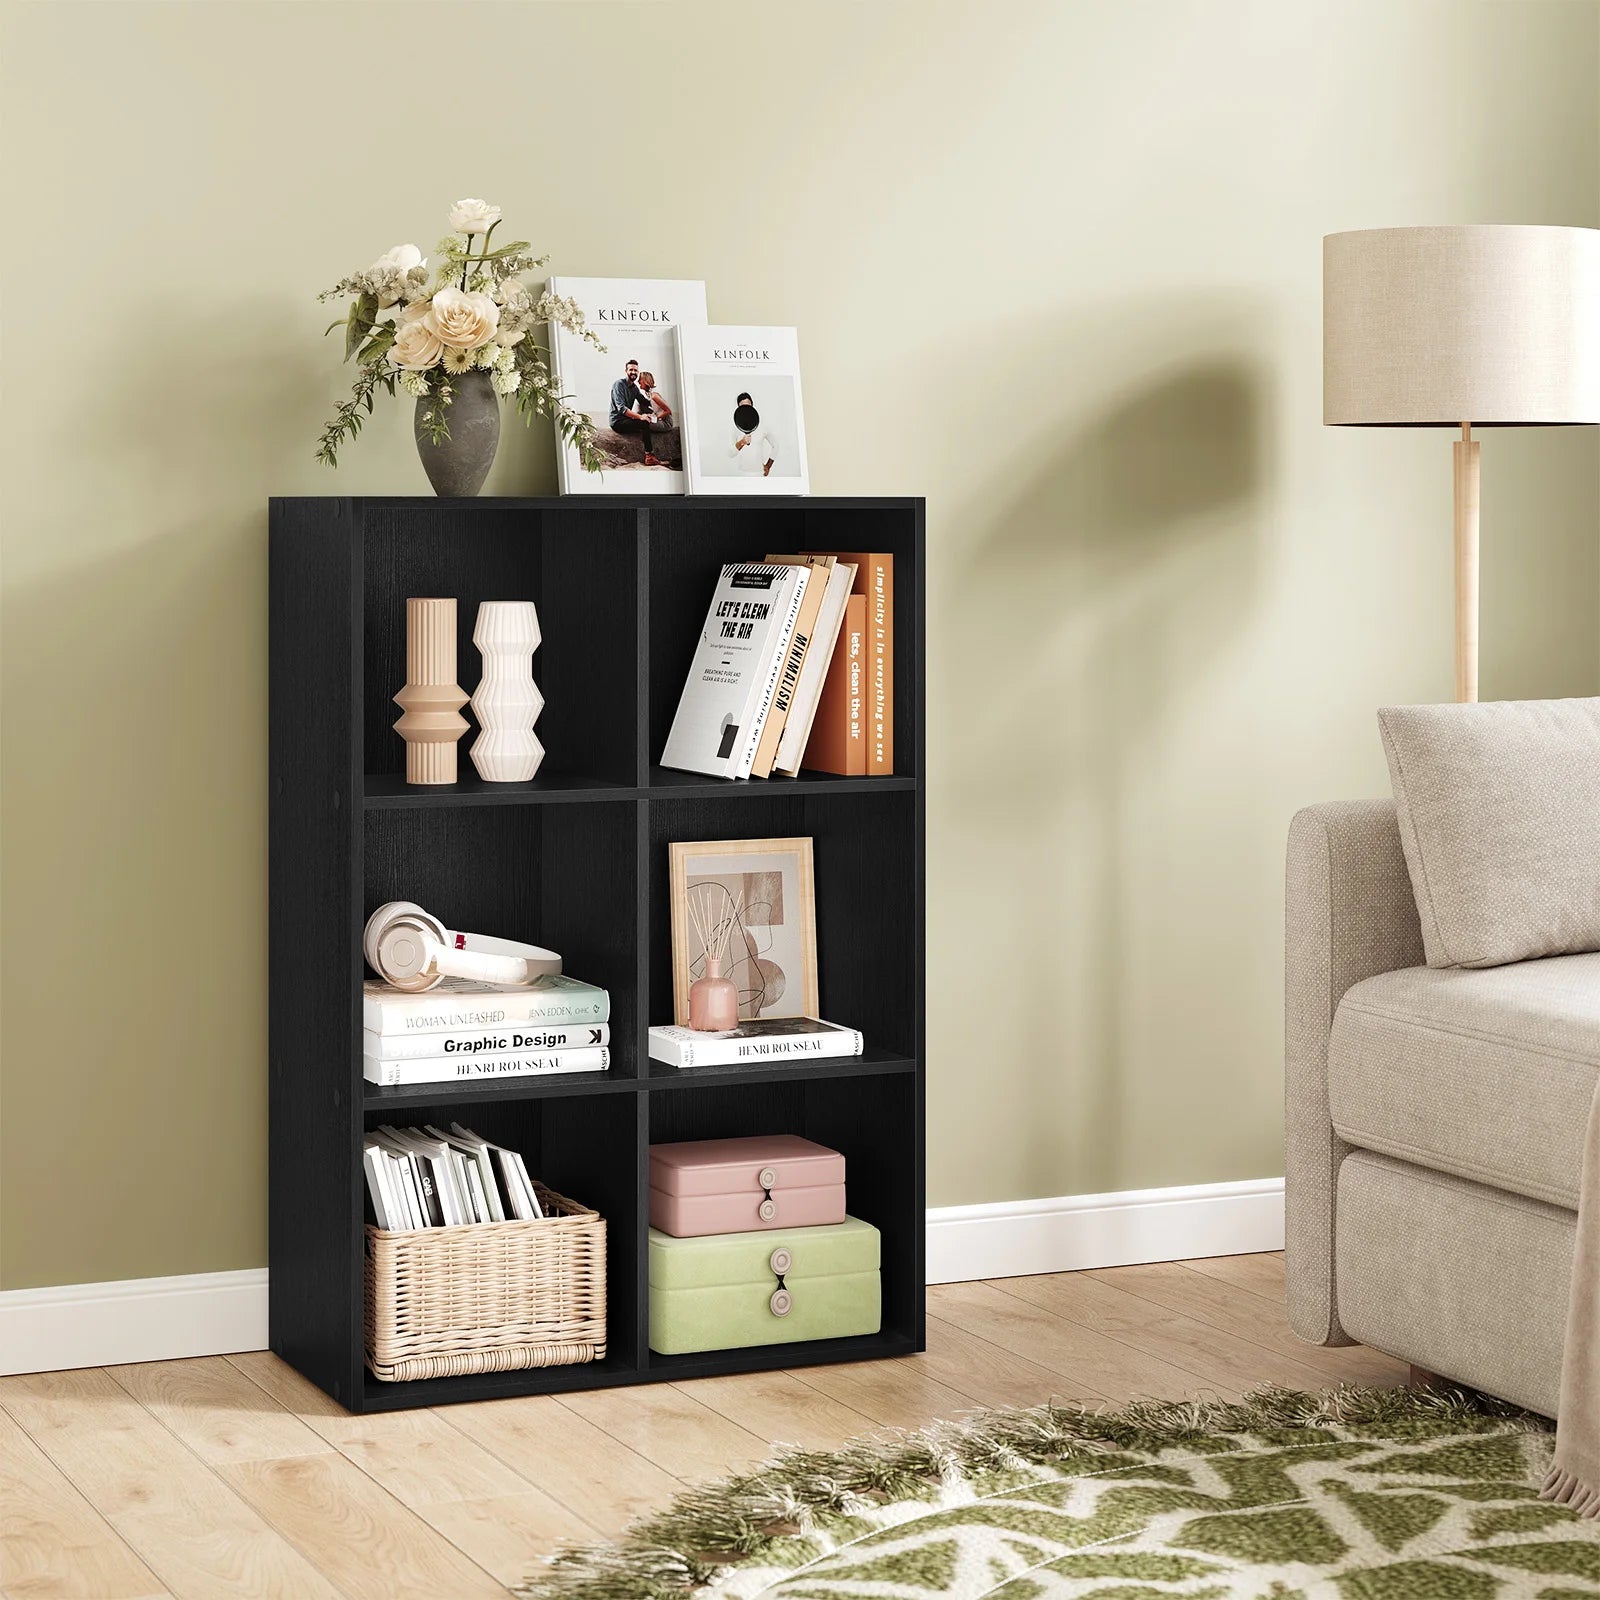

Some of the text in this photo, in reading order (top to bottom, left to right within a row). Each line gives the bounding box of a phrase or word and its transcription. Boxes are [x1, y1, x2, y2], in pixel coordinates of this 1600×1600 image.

[598, 309, 671, 322] KINFOLK
[714, 349, 770, 360] KINFOLK
[716, 601, 741, 618] LET'S
[740, 602, 770, 620] CLEAN
[720, 621, 738, 638] THE
[737, 622, 754, 639] AIR
[745, 580, 805, 765] simplicity is in everything we see
[775, 632, 808, 712] MINIMALISM
[875, 566, 885, 762] simplicity is in everything we see
[849, 632, 861, 739] lets, clean the air
[405, 1010, 505, 1029] WOMAN UNLEASHED
[528, 1008, 546, 1020] JENN
[547, 1006, 573, 1017] EDDEN,
[444, 1032, 567, 1053] Graphic Design
[738, 1039, 824, 1056] HENRI ROUSSEAU
[457, 1057, 563, 1076] HENRI ROUSSEAU
